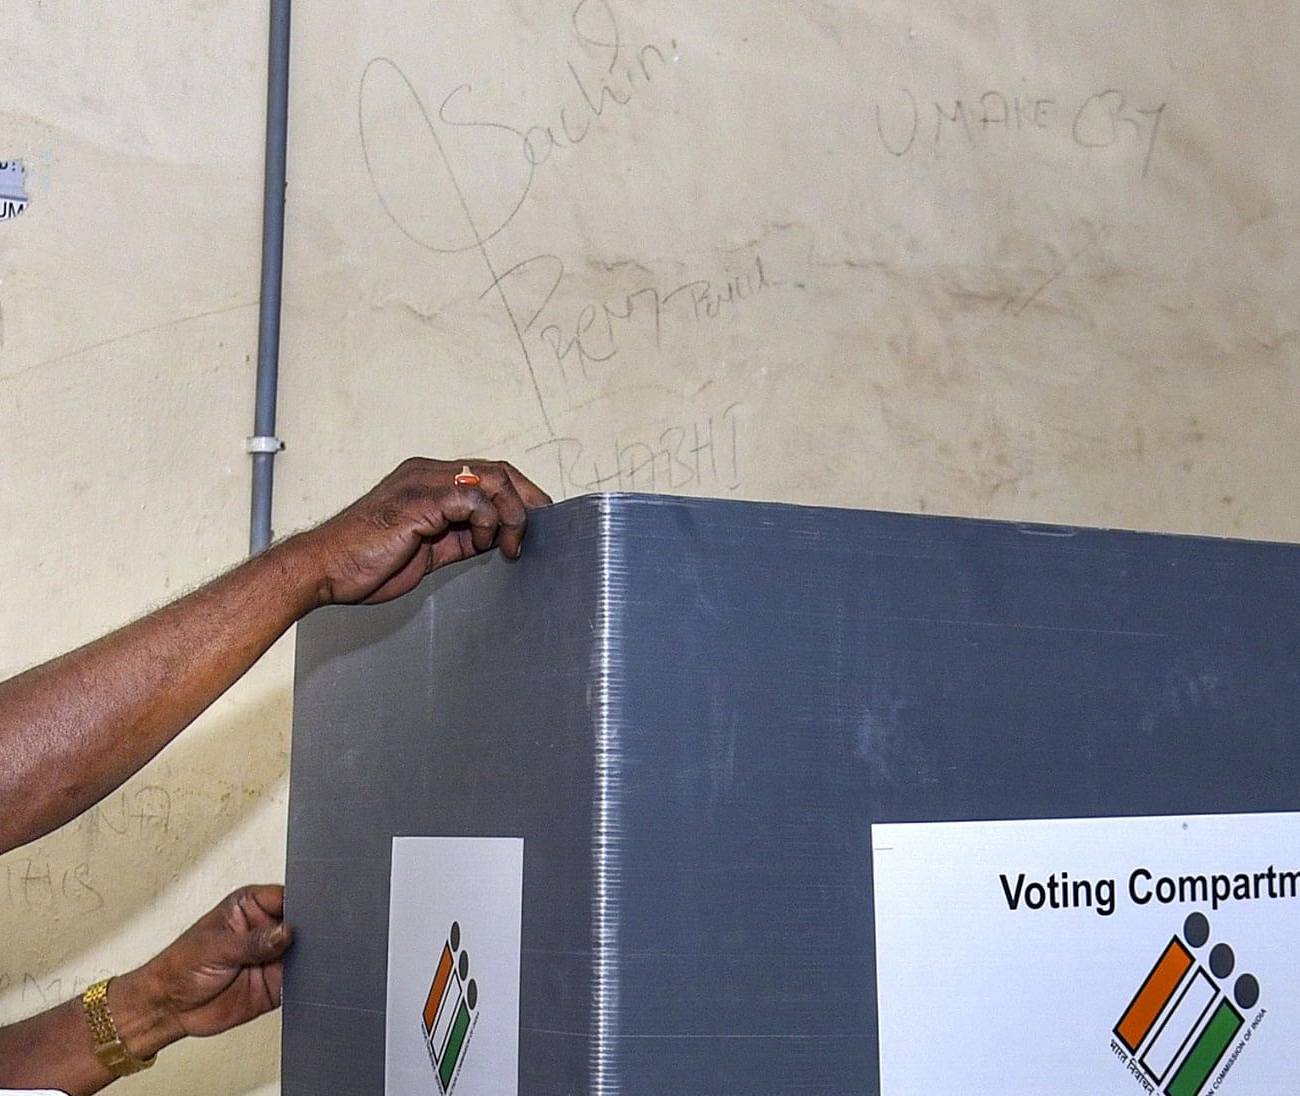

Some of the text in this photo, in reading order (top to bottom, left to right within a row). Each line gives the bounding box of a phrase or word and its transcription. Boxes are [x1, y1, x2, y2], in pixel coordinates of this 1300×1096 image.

[999, 873, 1116, 916] Voting
[1213, 1041, 1246, 1090] COMMISSION
[1243, 1030, 1251, 1041] OF
[1251, 1008, 1267, 1030] INDIA
